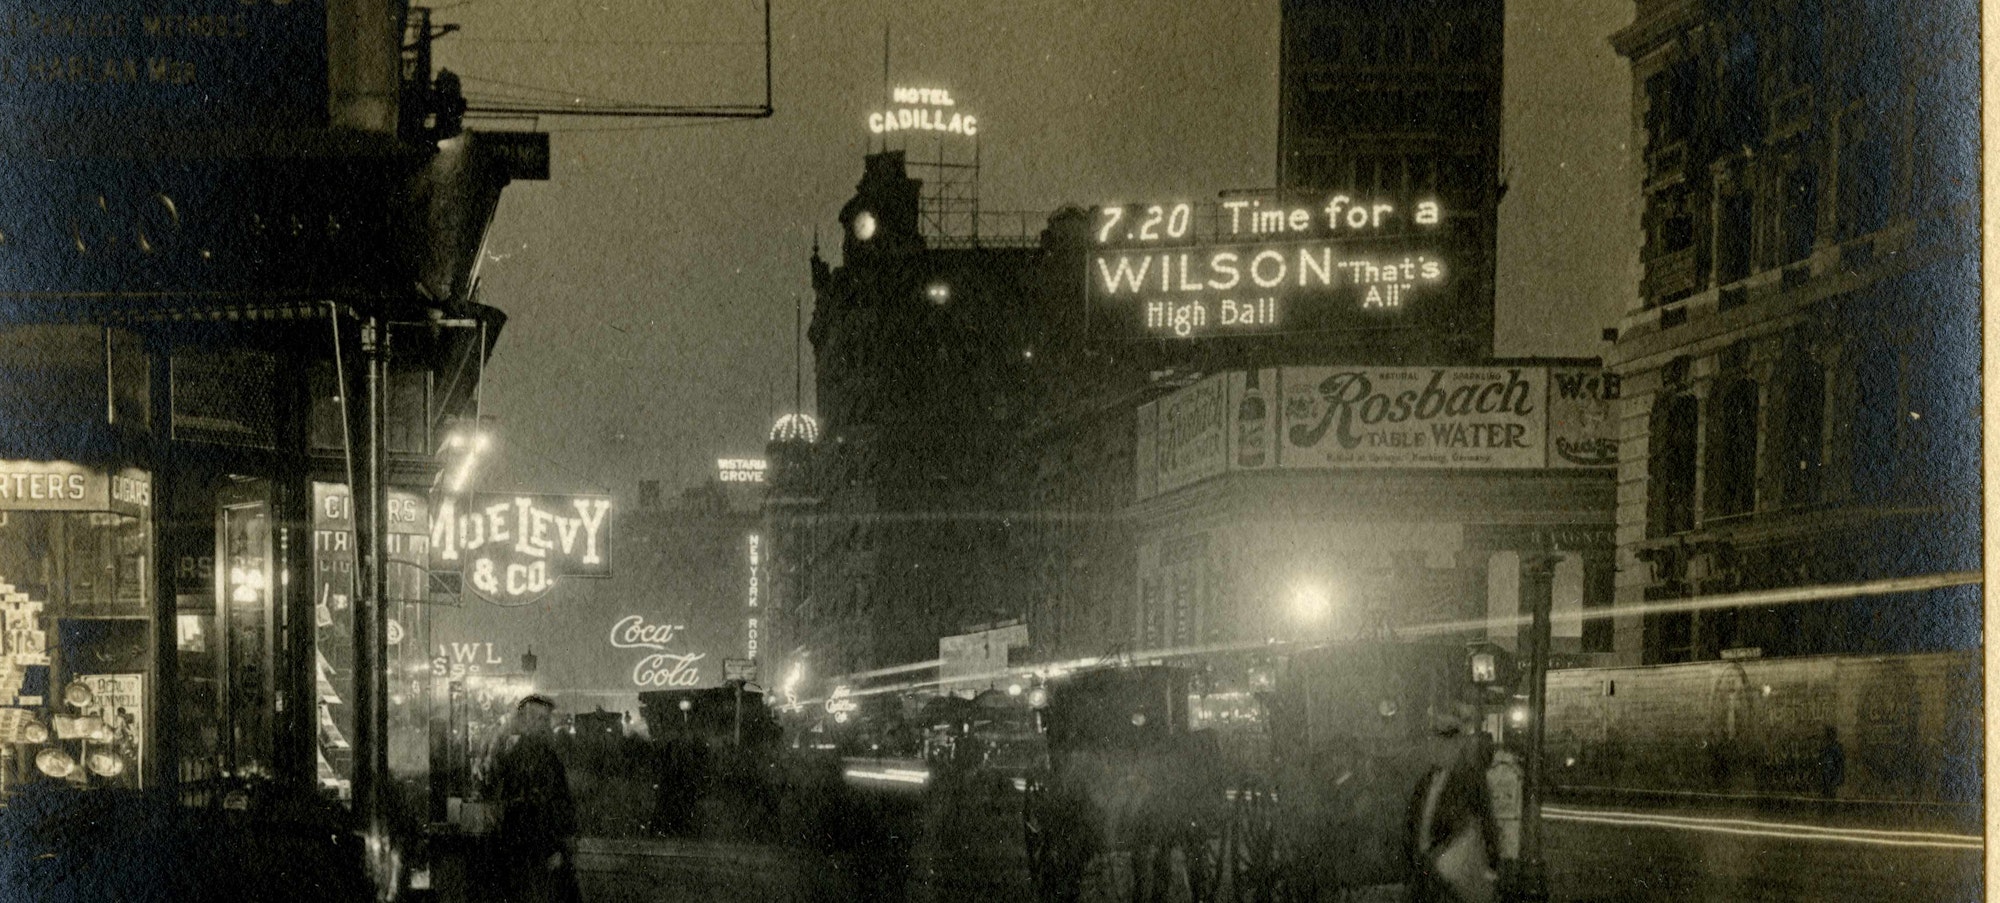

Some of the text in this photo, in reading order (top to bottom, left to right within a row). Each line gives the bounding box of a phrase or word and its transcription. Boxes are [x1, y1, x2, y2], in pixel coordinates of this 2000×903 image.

[893, 87, 954, 106] HOTEL
[868, 108, 977, 136] CADILLAC
[1223, 200, 1310, 234] Time
[1324, 194, 1393, 229] for
[1415, 201, 1439, 224] a
[1098, 247, 1331, 293] WILSON
[1148, 298, 1275, 336] High Ball
[1289, 369, 1533, 449] Rosbach
[1368, 423, 1533, 448] TABLE WATER
[113, 475, 148, 506] CIGARS
[719, 470, 764, 482] GROVE
[515, 496, 610, 564] LEVY
[473, 558, 553, 596] & CO.
[748, 534, 759, 660] NEW YORK ROOF
[633, 653, 706, 686] Cola
